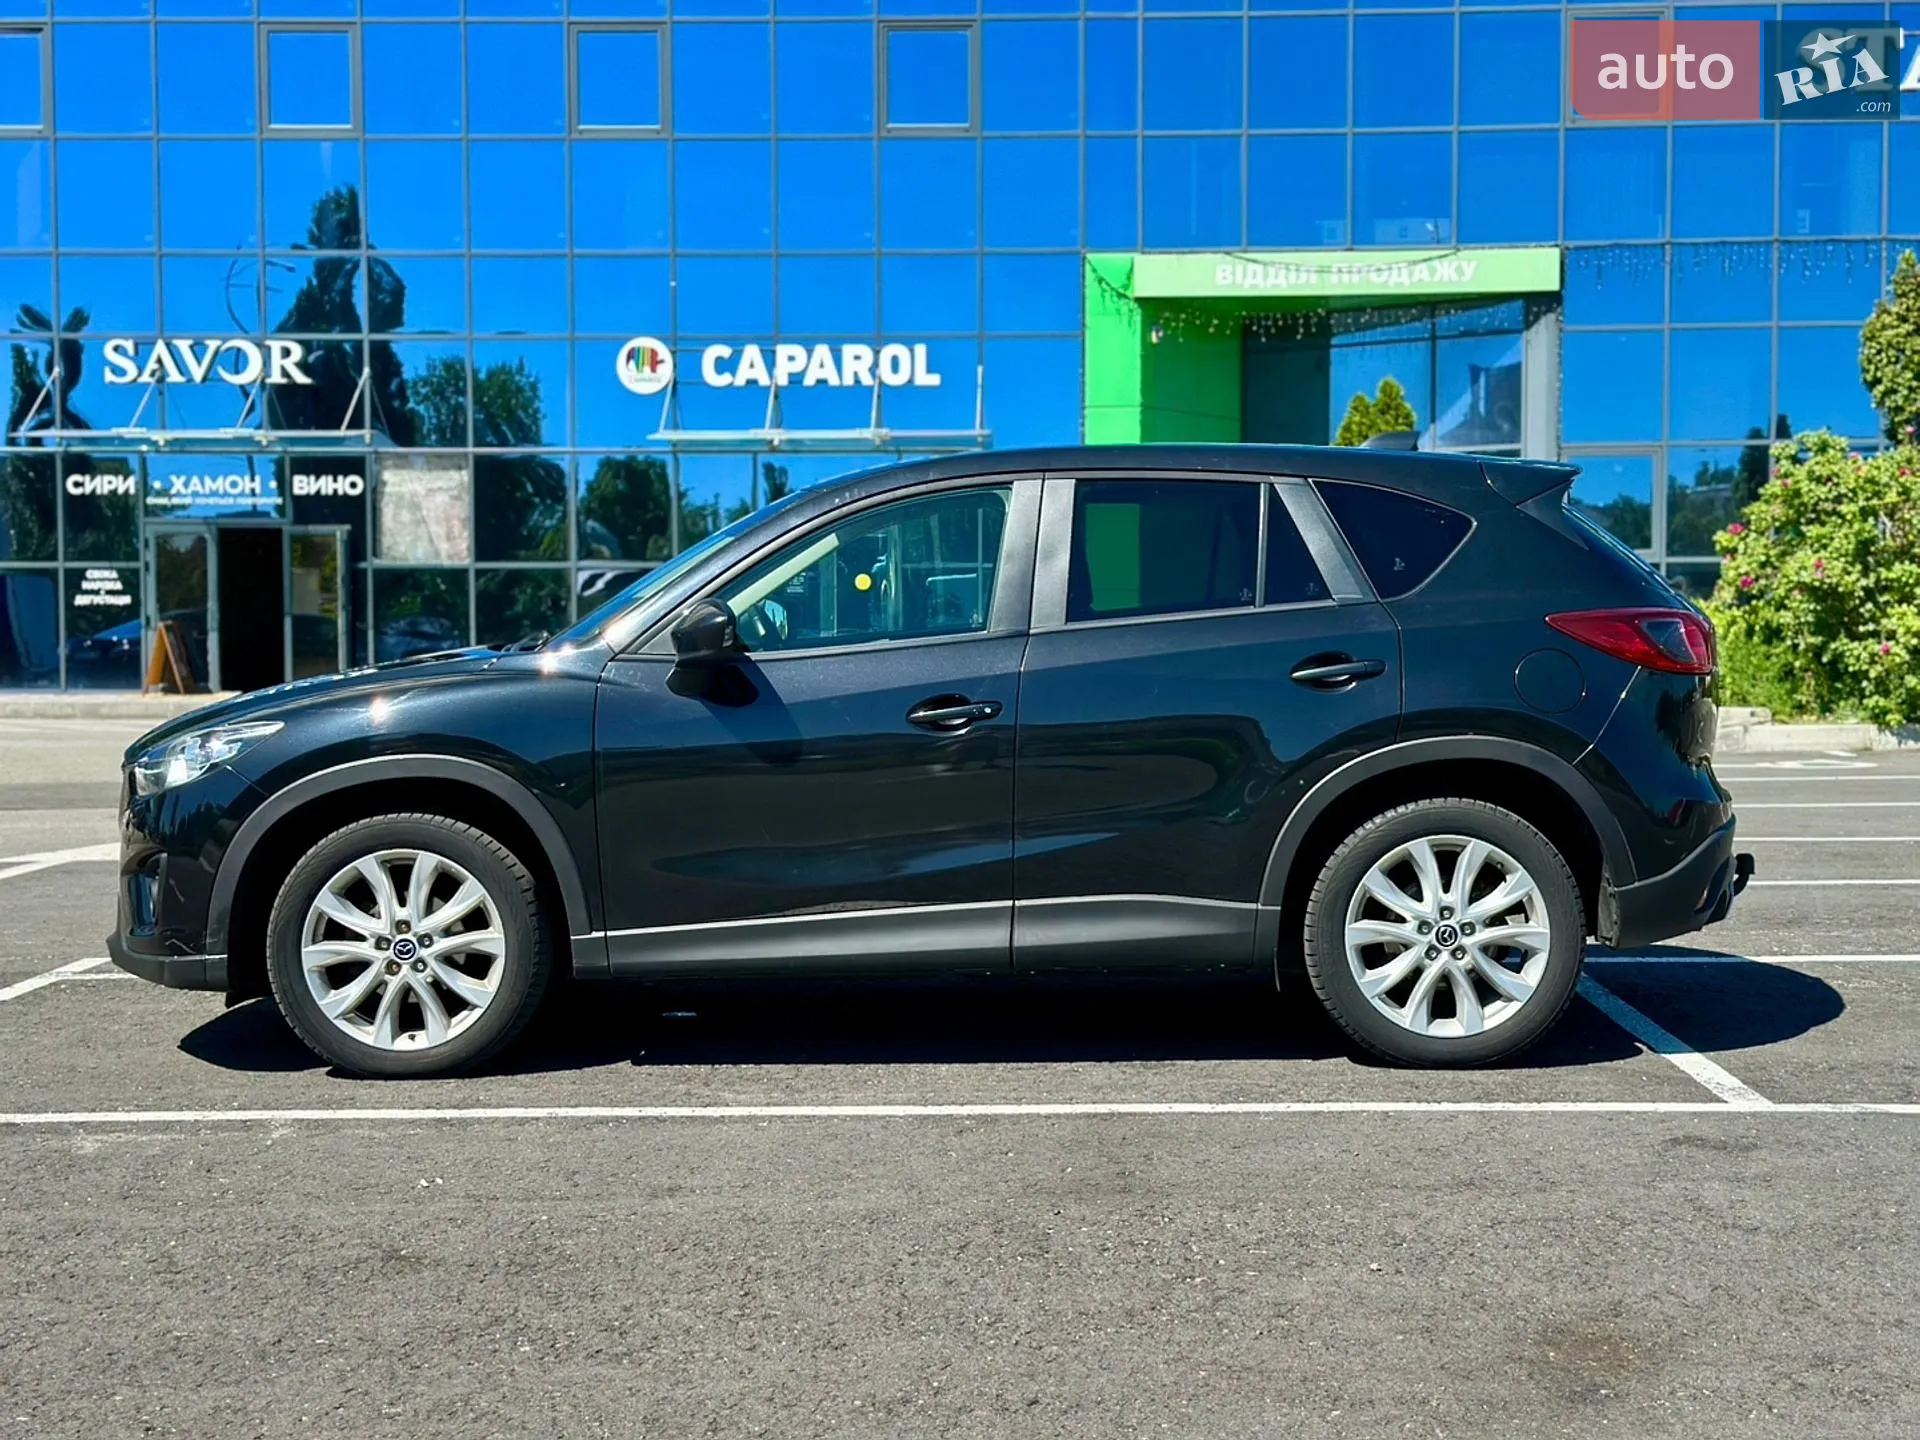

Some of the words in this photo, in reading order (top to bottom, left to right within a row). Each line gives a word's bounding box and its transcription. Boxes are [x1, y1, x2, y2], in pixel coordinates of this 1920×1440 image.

[1330, 260, 1477, 287] ПРОДАЖУ
[701, 343, 941, 387] CAPAROL
[65, 474, 136, 497] СИРИ
[169, 474, 261, 496] ХАМОН
[292, 474, 365, 497] ВИНО
